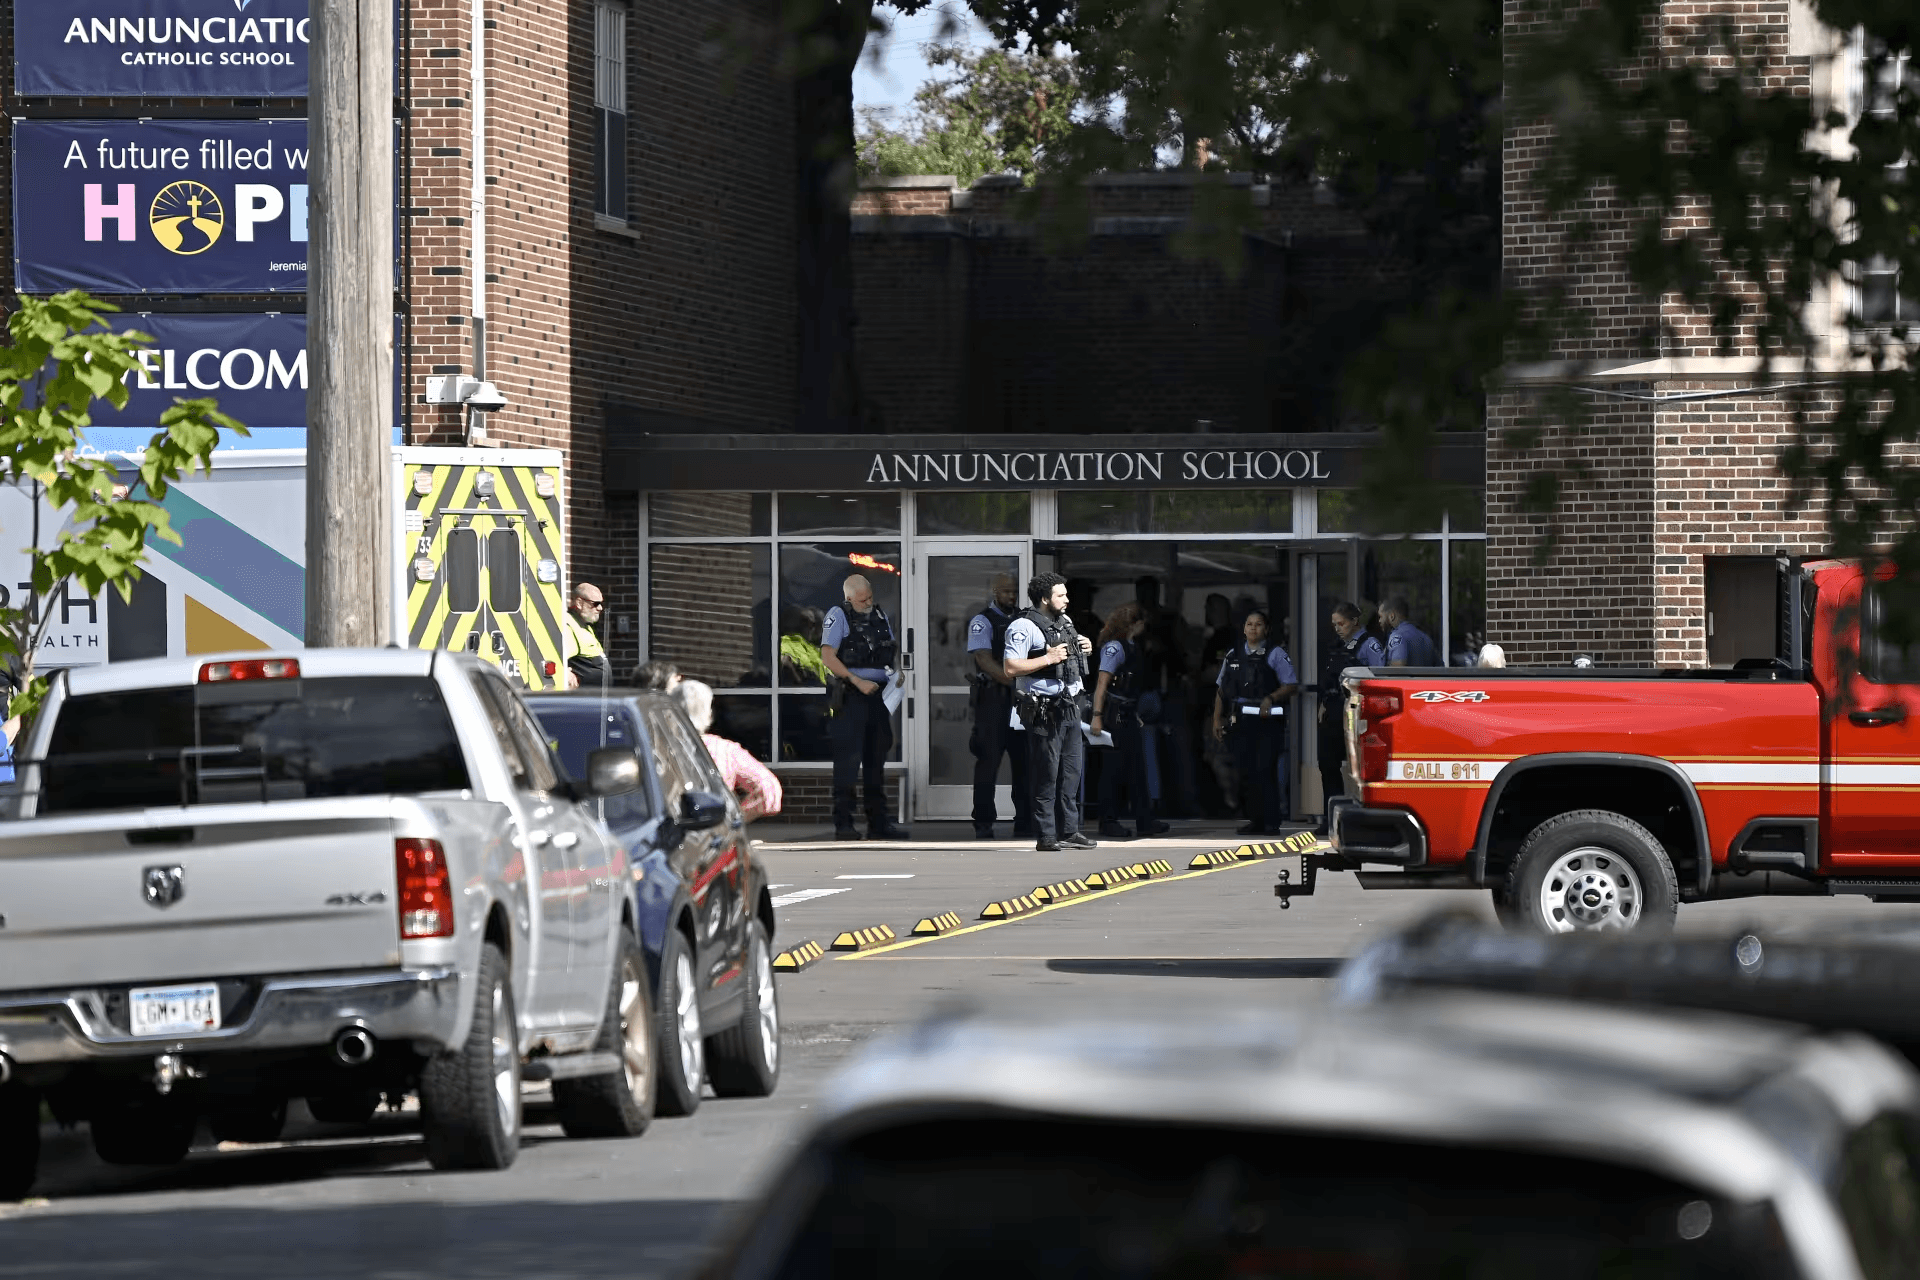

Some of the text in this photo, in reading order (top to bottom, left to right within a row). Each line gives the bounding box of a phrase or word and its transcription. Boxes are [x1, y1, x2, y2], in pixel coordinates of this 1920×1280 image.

[120, 51, 295, 65] CATHOLIC SCHOOL
[63, 140, 87, 169] A
[97, 138, 190, 169] future
[199, 139, 273, 170] filled
[268, 260, 309, 272] Jeremia
[120, 348, 309, 390] ELCOM
[866, 450, 1331, 482] ANNUNCIATION SCHOOL
[1403, 762, 1480, 779] CALL 911
